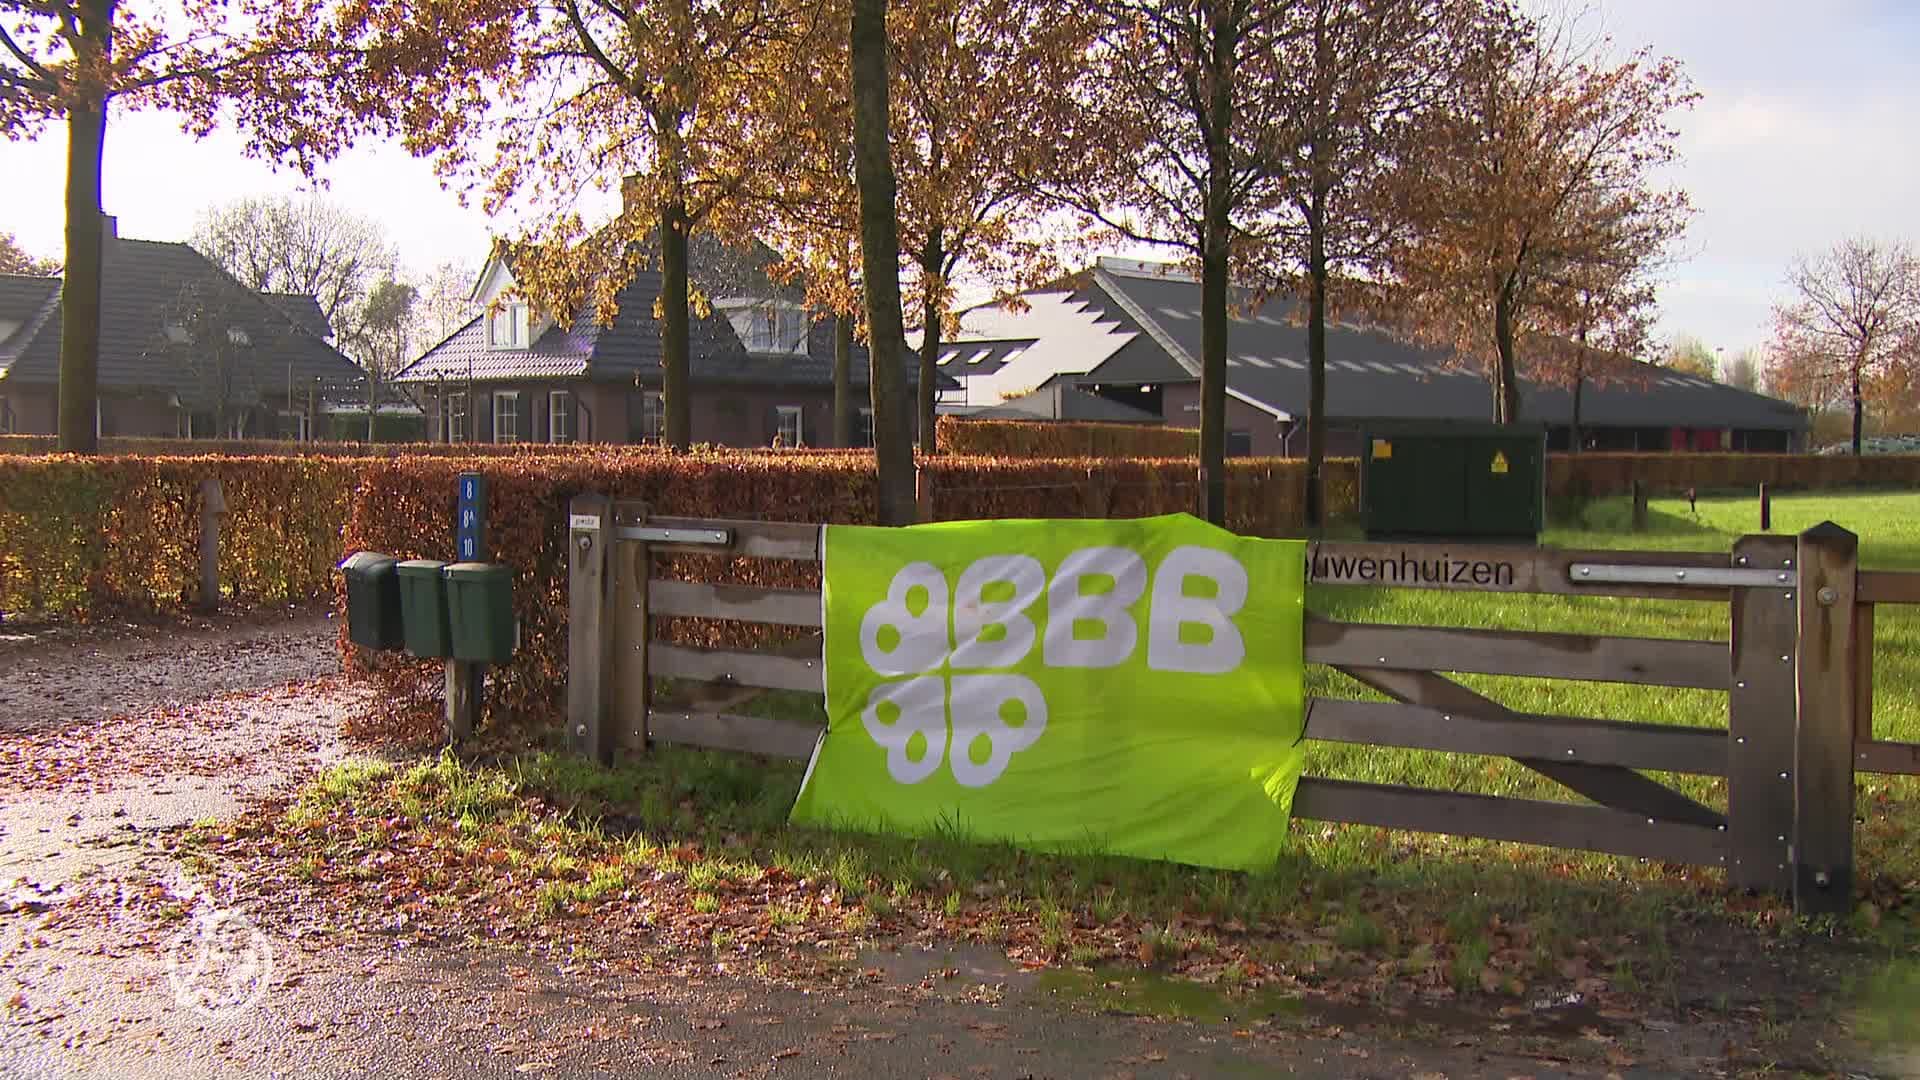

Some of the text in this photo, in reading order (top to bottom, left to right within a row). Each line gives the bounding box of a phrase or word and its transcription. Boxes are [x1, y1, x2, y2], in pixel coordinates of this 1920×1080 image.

[466, 481, 473, 499] 8
[463, 538, 473, 557] 10
[1305, 551, 1514, 585] uwenhuizen
[949, 545, 1249, 674] BBB
